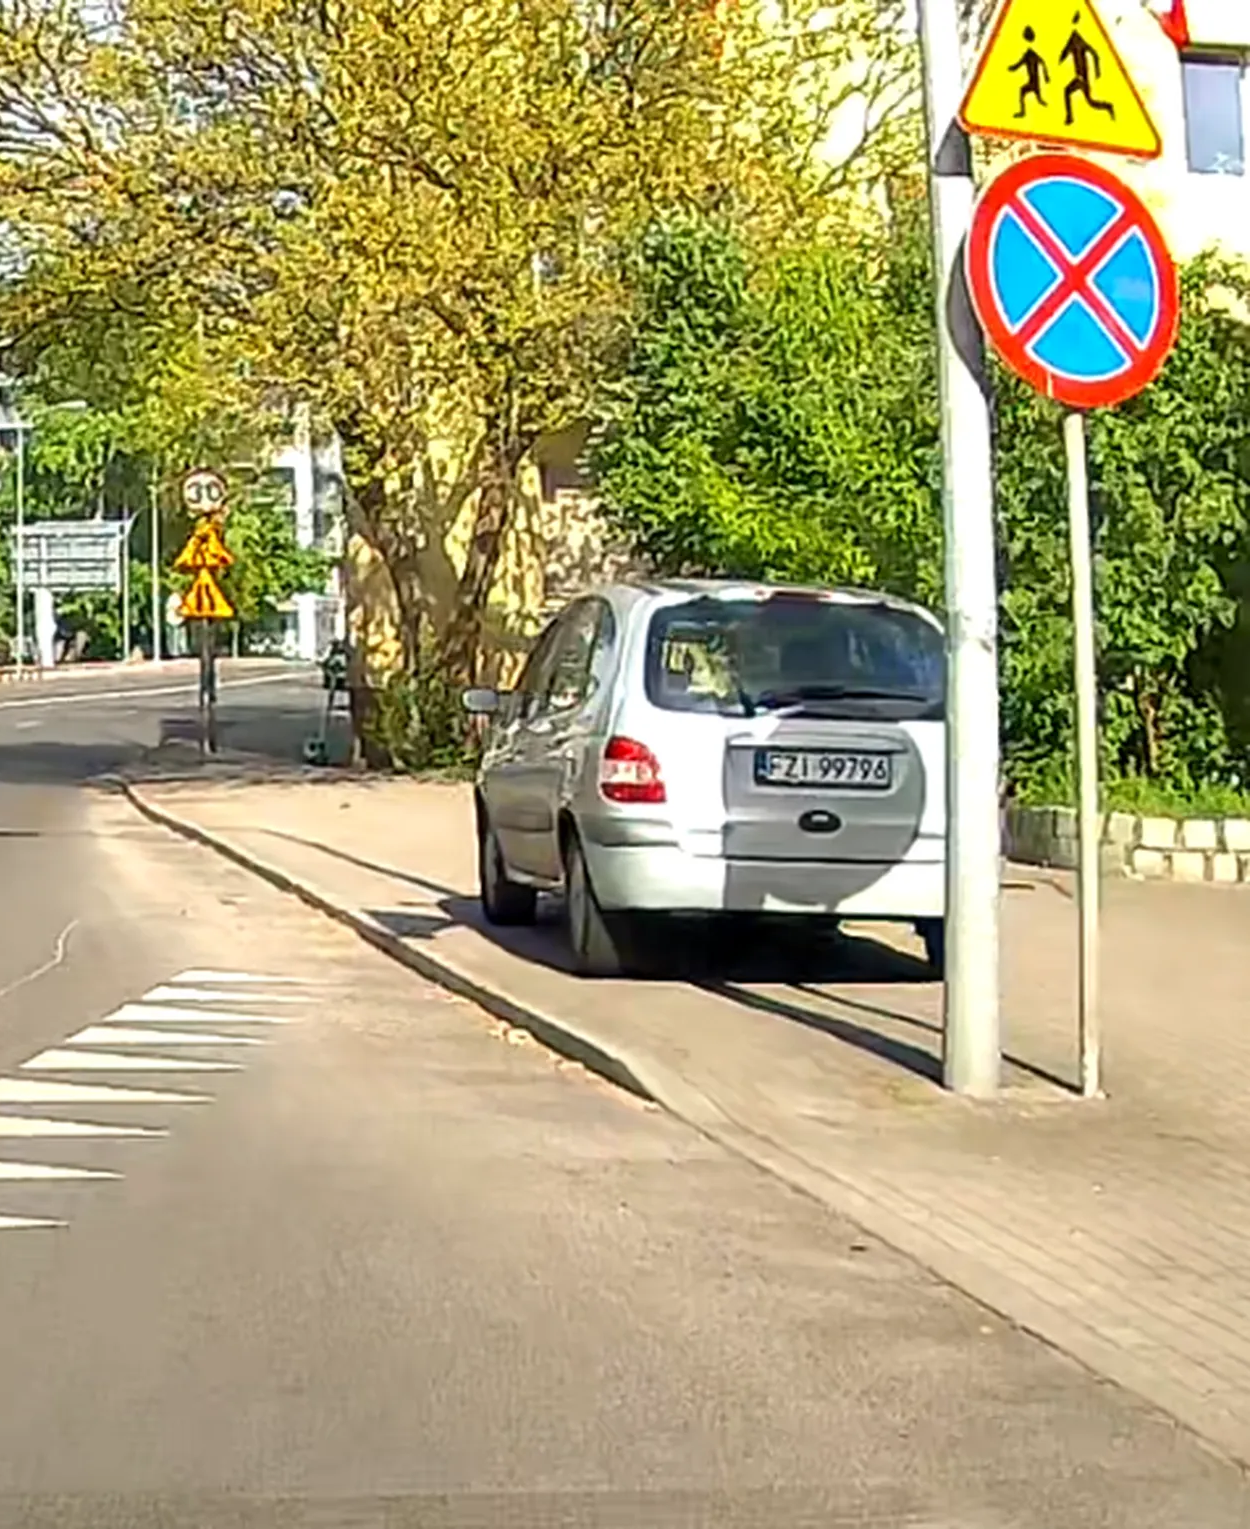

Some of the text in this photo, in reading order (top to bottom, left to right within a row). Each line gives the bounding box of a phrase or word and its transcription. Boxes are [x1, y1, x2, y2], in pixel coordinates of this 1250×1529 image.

[187, 480, 223, 504] 30
[770, 754, 887, 780] FZI 99796
